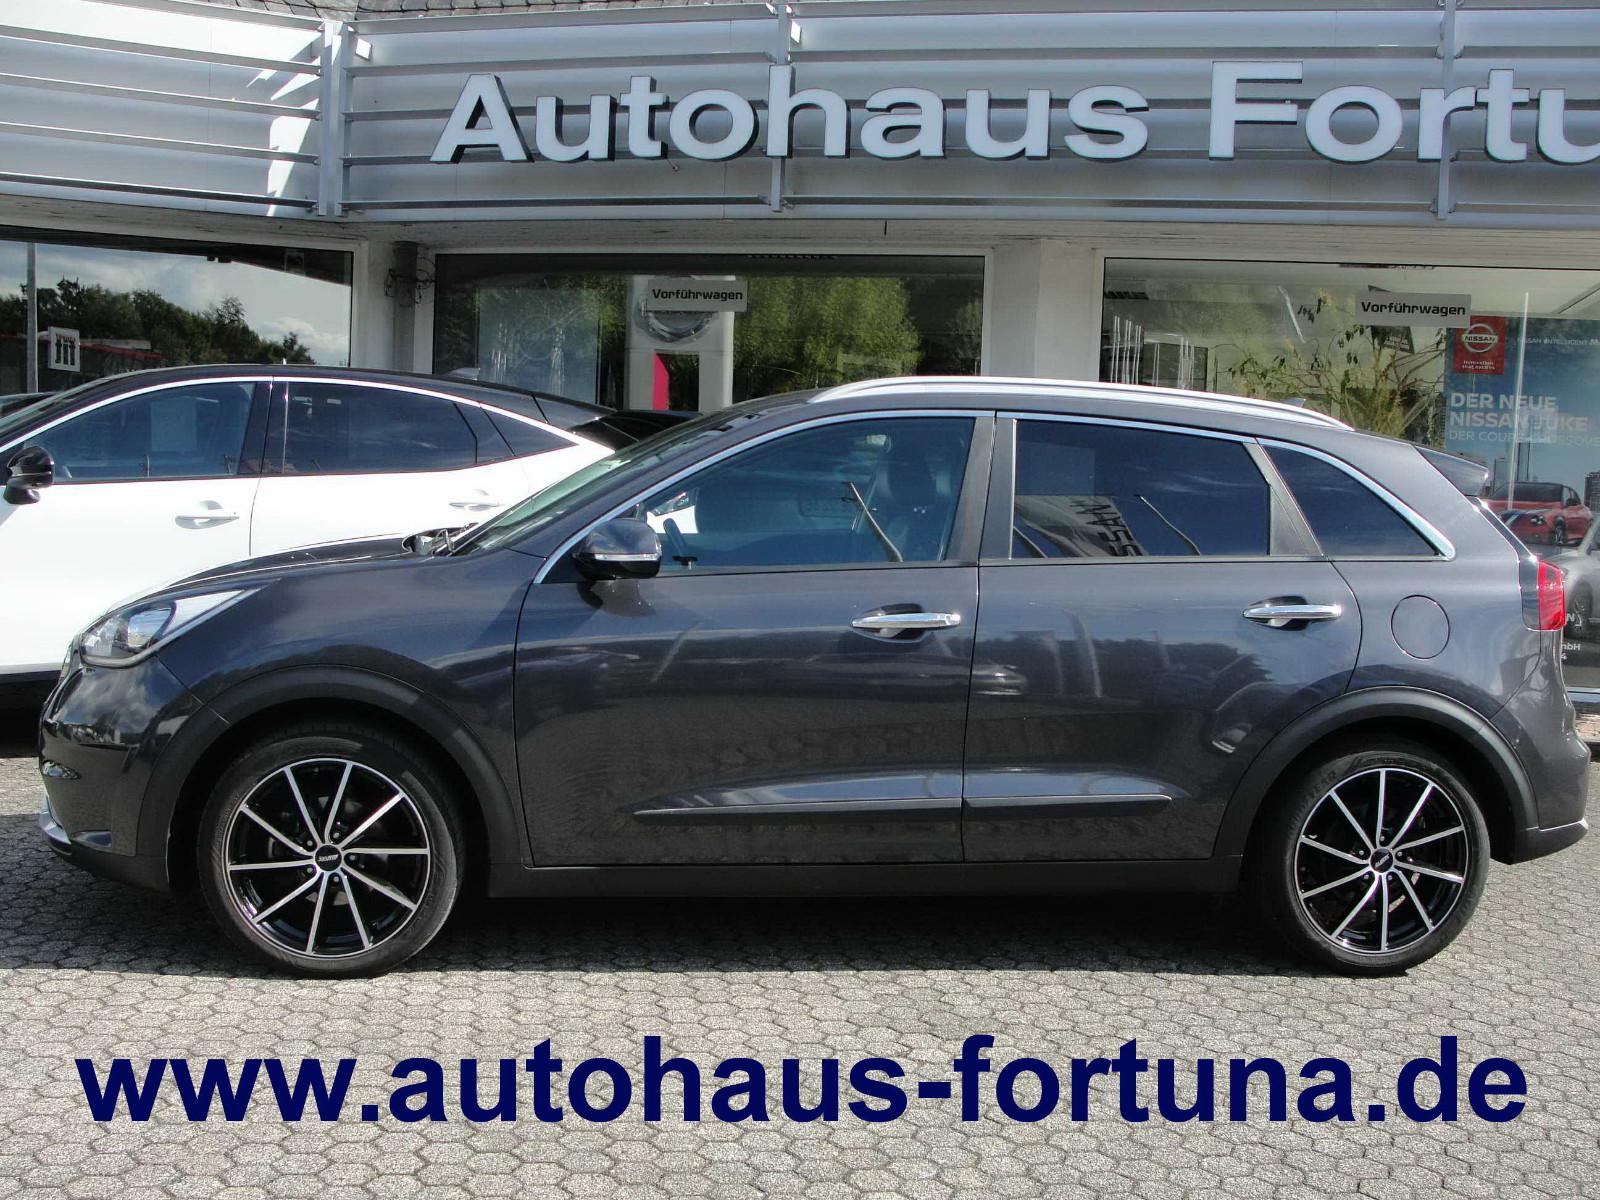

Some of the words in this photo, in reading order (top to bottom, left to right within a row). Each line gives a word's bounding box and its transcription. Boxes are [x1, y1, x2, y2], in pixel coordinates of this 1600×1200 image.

[430, 64, 1150, 162] Autohaus
[1208, 61, 1600, 165] Fortu
[652, 288, 743, 302] Vorführwagen
[1361, 301, 1466, 318] Vorführwagen
[1451, 392, 1493, 408] DER
[1500, 394, 1557, 411] NEUE
[1450, 431, 1475, 441] DER
